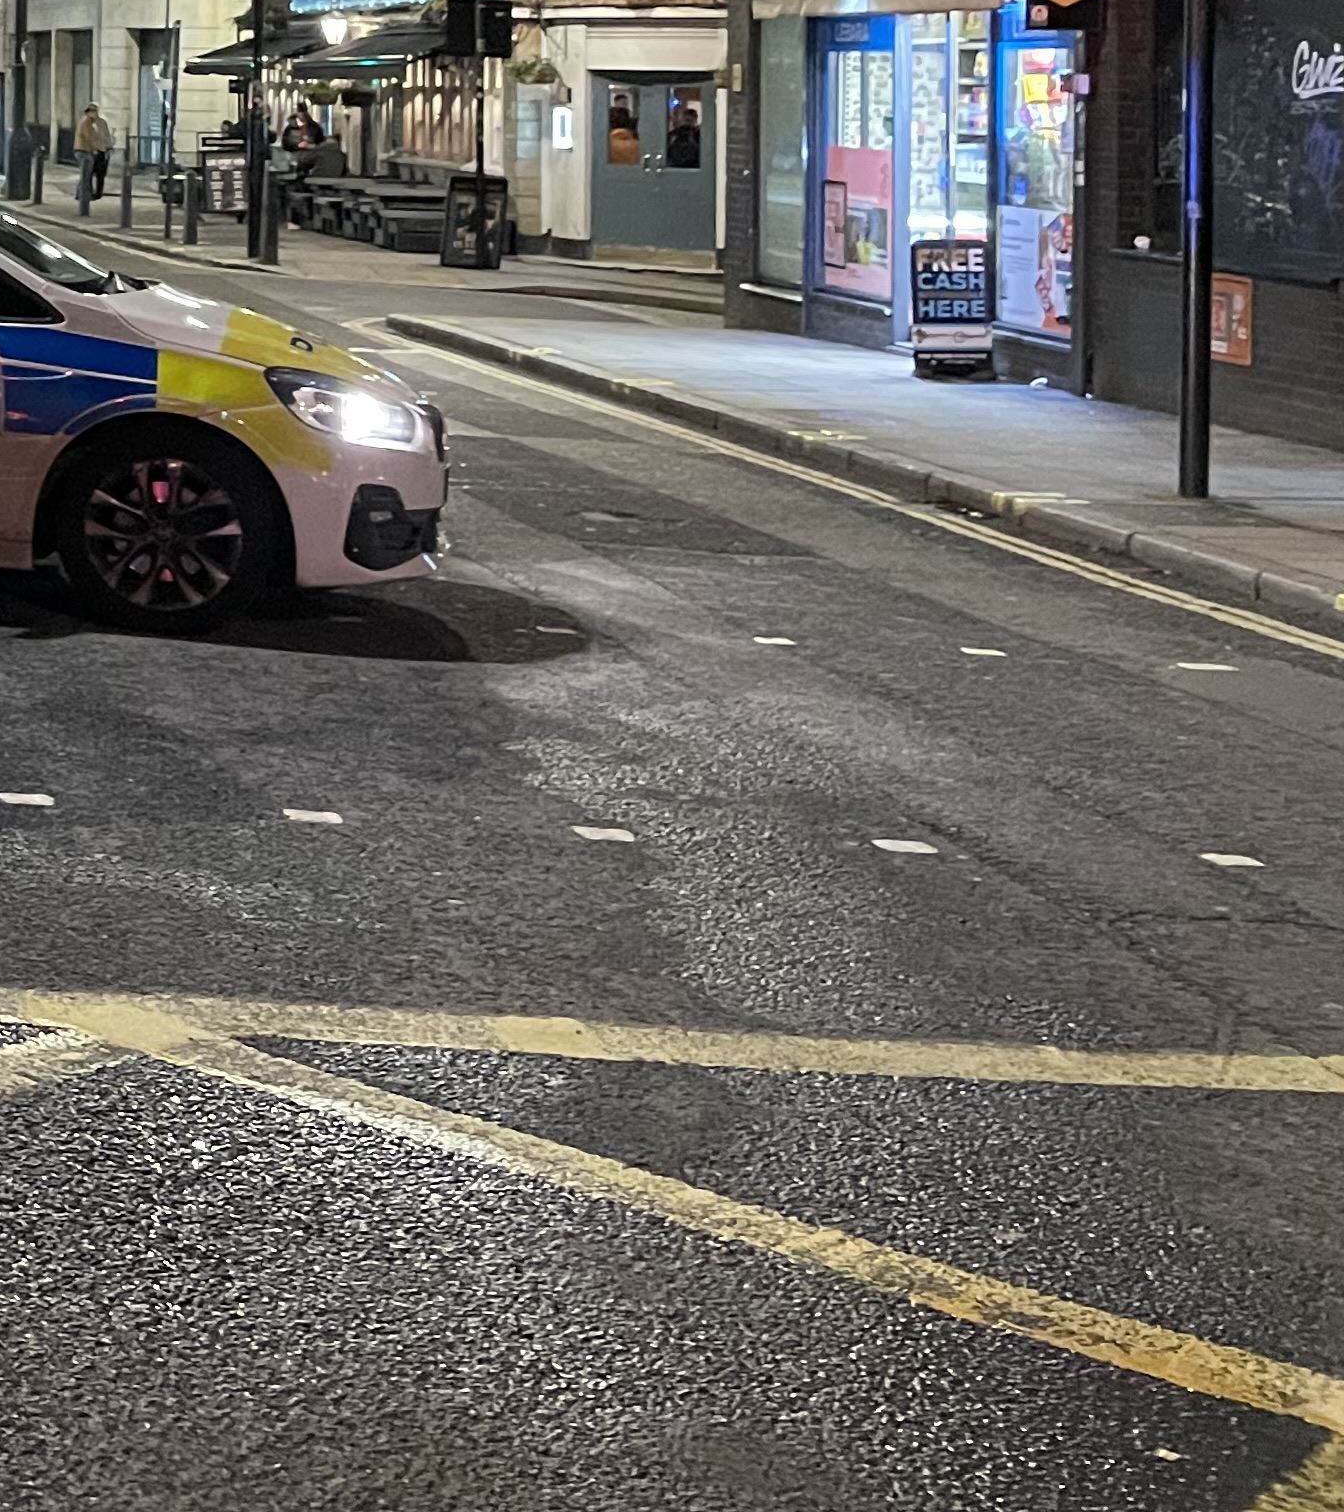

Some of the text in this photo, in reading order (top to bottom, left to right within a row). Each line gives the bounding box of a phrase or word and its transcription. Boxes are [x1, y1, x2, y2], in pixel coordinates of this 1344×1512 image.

[917, 248, 985, 272] FREE
[918, 273, 985, 290] CASH
[919, 300, 985, 318] HERE
